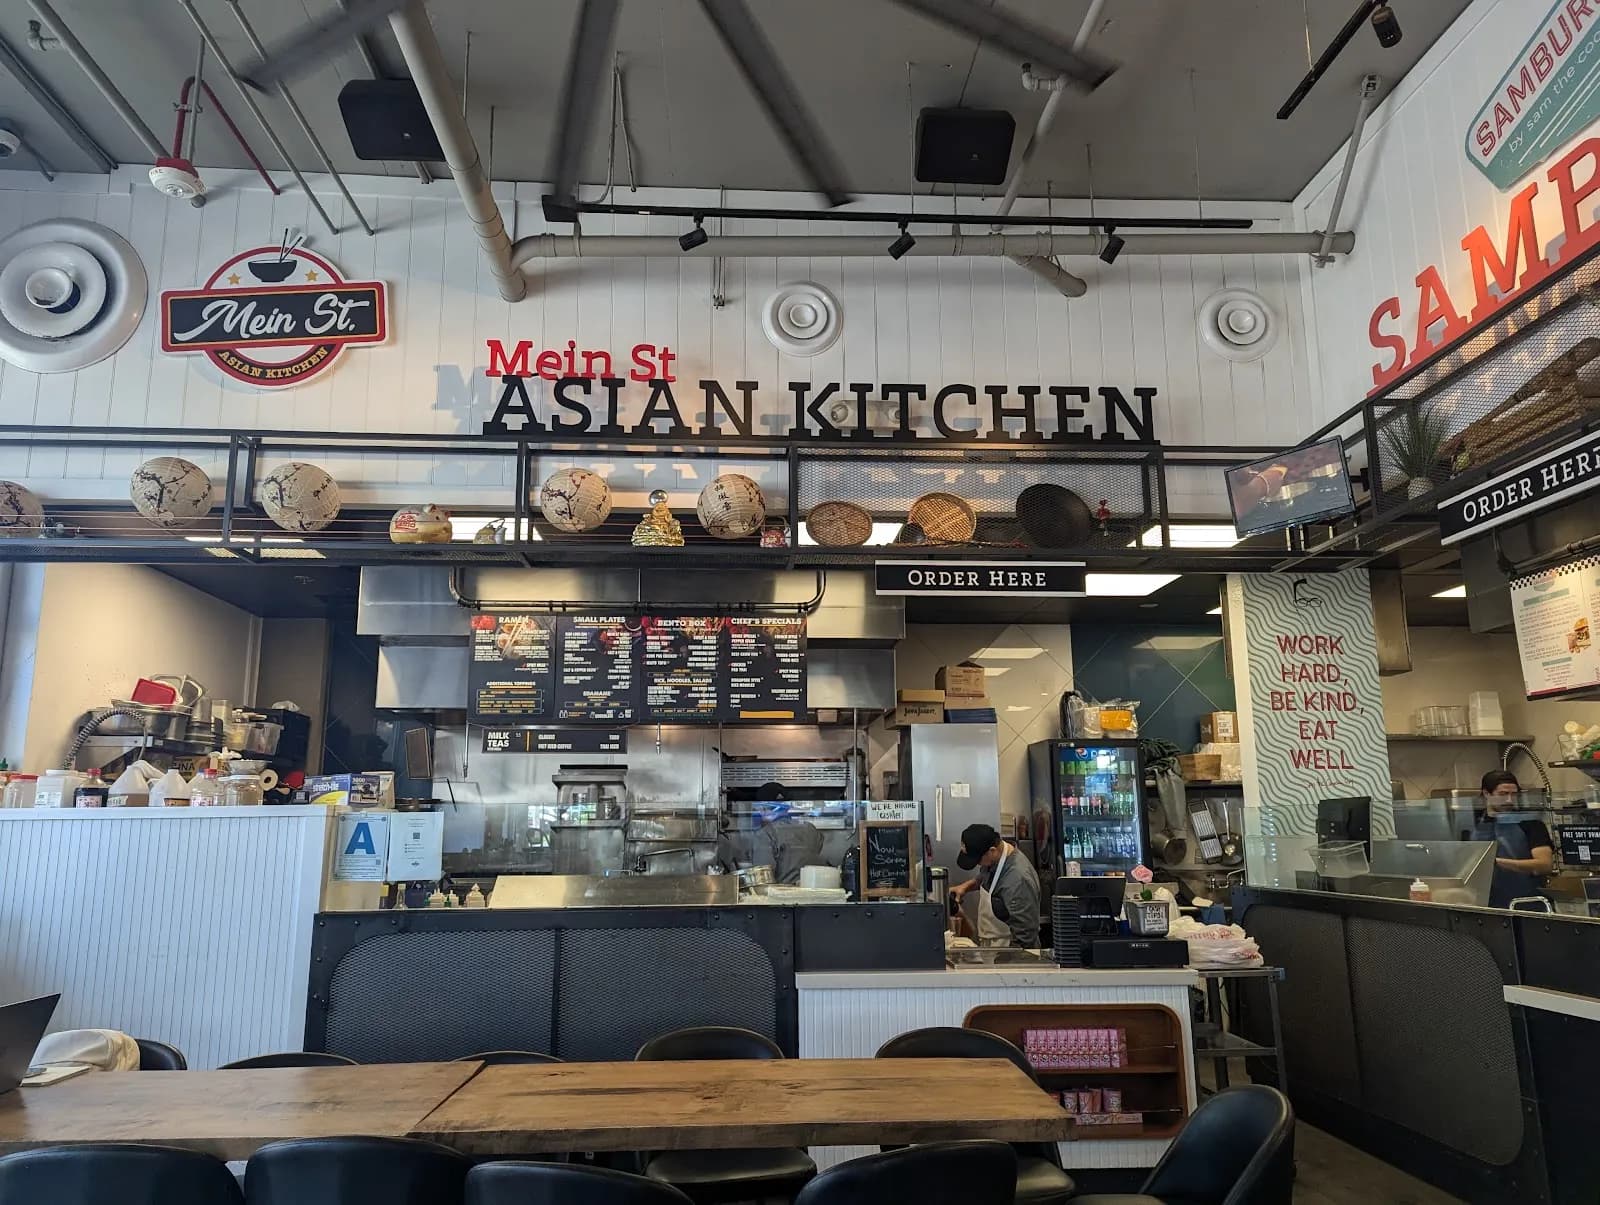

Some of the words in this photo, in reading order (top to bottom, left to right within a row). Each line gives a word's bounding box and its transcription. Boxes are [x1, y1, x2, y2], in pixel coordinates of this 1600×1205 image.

[1476, 0, 1600, 157] SAMBUR
[1508, 131, 1524, 153] by
[1526, 97, 1552, 130] sam
[1552, 66, 1576, 95] the
[174, 300, 296, 342] Mein
[304, 293, 370, 335] St.
[218, 350, 261, 378] ASIAN
[265, 346, 328, 379] KITCHEN
[485, 339, 616, 381] Mein
[630, 344, 676, 383] St
[482, 374, 759, 437] ASIAN
[788, 382, 1160, 442] KITCHEN
[1463, 477, 1534, 523] ORDER
[908, 569, 979, 586] ORDER
[988, 570, 1047, 587] HERE
[657, 619, 687, 627] BENTO
[688, 619, 706, 627] BOX
[731, 617, 760, 625] CHEF'S
[761, 617, 802, 625] SPECIALS
[1276, 635, 1344, 655] WORK
[1281, 663, 1348, 686] HARD,
[1270, 691, 1297, 711] BE
[1303, 691, 1365, 715] KIND,
[487, 731, 510, 740] MILK
[1298, 720, 1338, 740] EAT
[487, 739, 510, 748] TEAS
[1289, 749, 1354, 770] WELL
[344, 822, 377, 855] A
